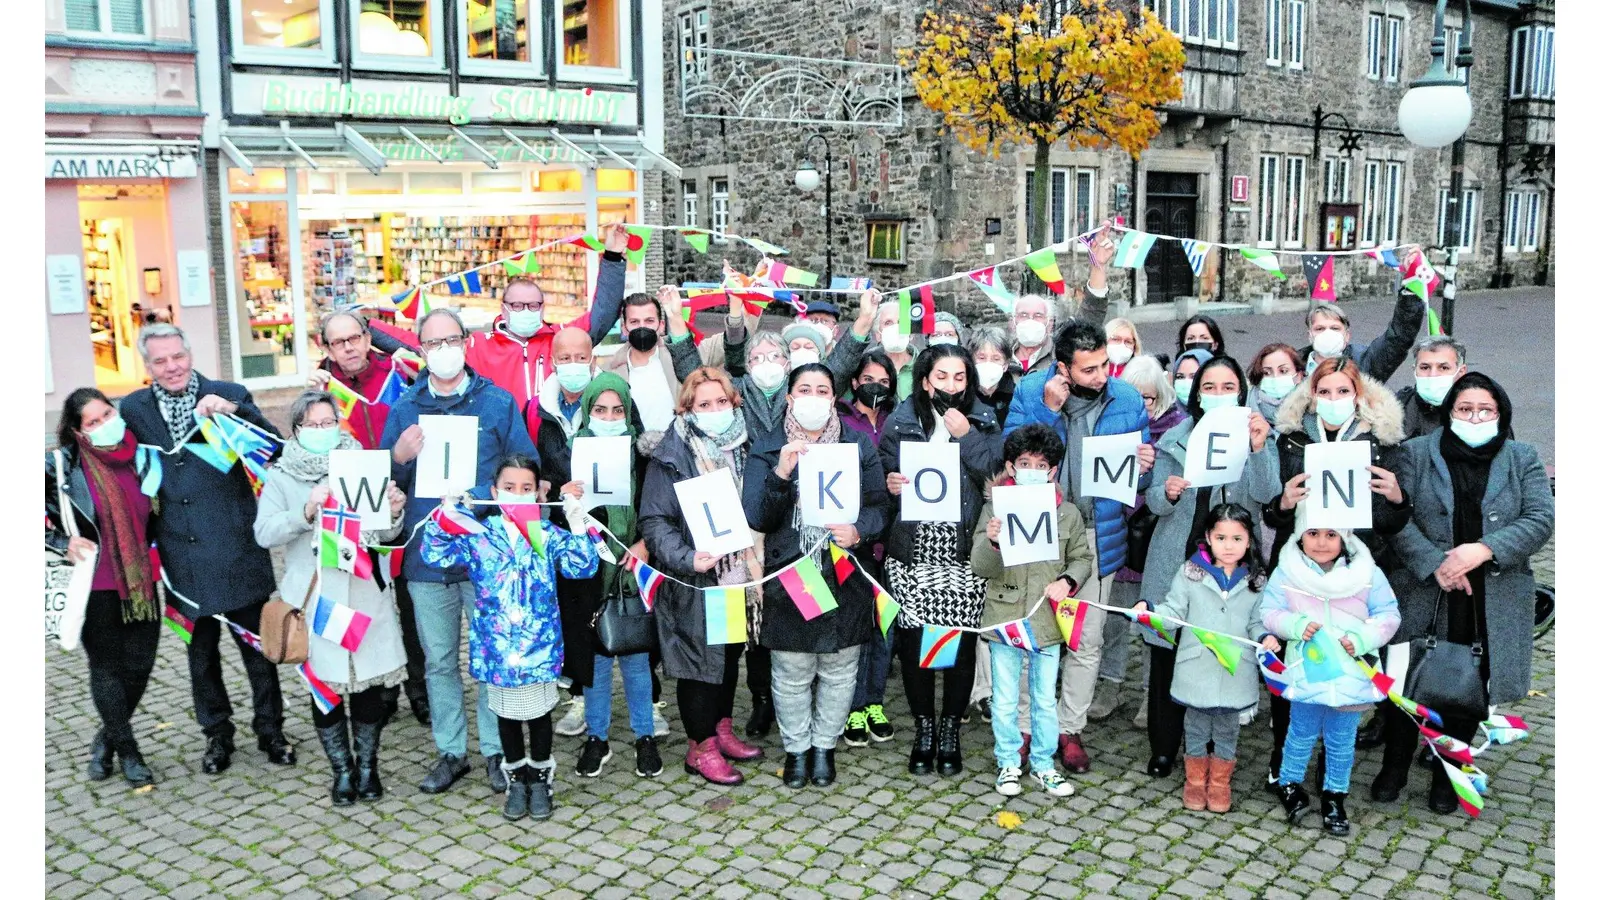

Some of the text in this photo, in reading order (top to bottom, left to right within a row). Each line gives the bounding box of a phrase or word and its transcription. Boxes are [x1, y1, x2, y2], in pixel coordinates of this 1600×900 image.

[264, 80, 474, 125] Buchhandlung
[51, 158, 175, 178] AM MARKT
[649, 200, 657, 211] 2
[444, 442, 451, 480] I
[1206, 432, 1231, 471] E
[592, 462, 614, 495] L
[914, 467, 948, 503] O
[1093, 454, 1137, 488] M
[1322, 469, 1354, 508] N
[340, 477, 389, 512] W
[818, 471, 844, 509] K
[702, 501, 732, 538] L
[1006, 511, 1053, 546] M
